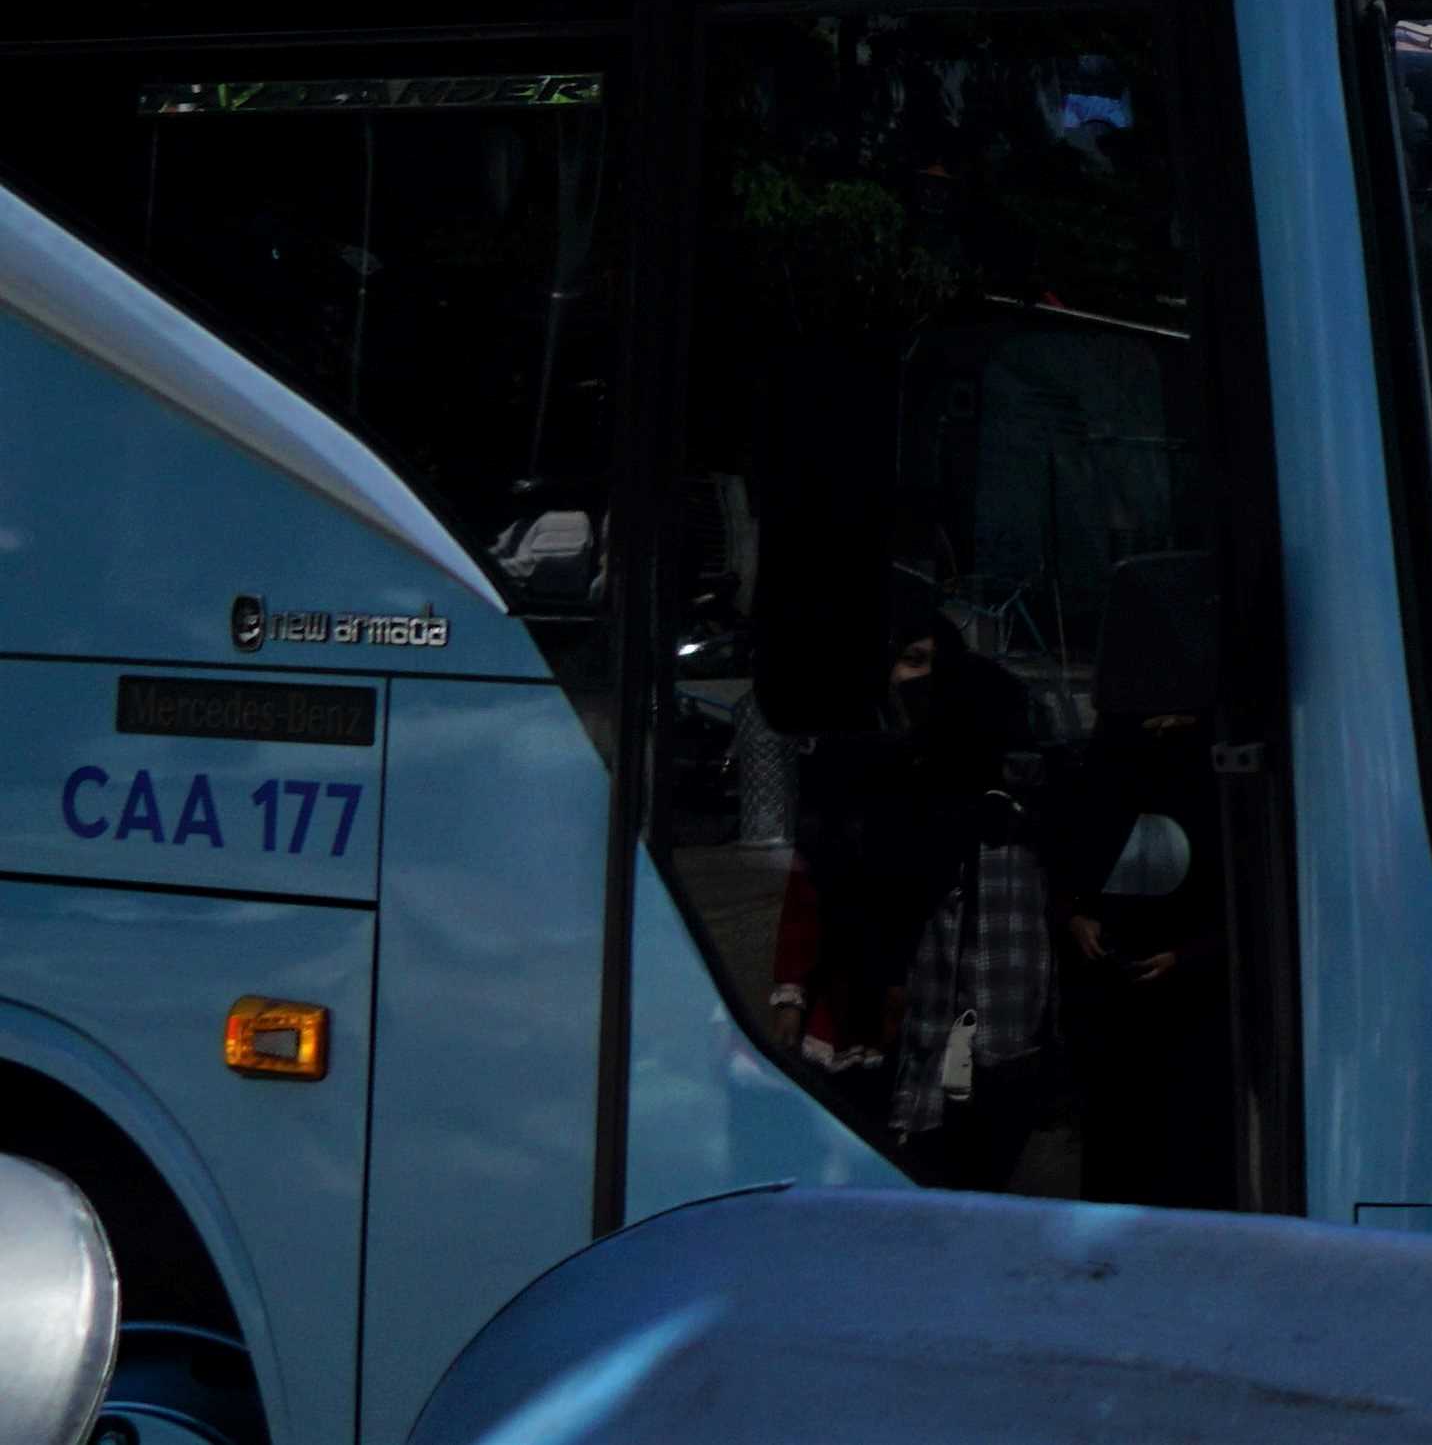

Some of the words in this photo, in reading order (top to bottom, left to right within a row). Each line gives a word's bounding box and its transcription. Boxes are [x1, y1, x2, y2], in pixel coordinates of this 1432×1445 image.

[267, 612, 327, 643] new
[334, 602, 449, 647] armada
[128, 686, 364, 738] Mercedes-Benz
[62, 765, 225, 849] CAA
[251, 778, 363, 858] 177
